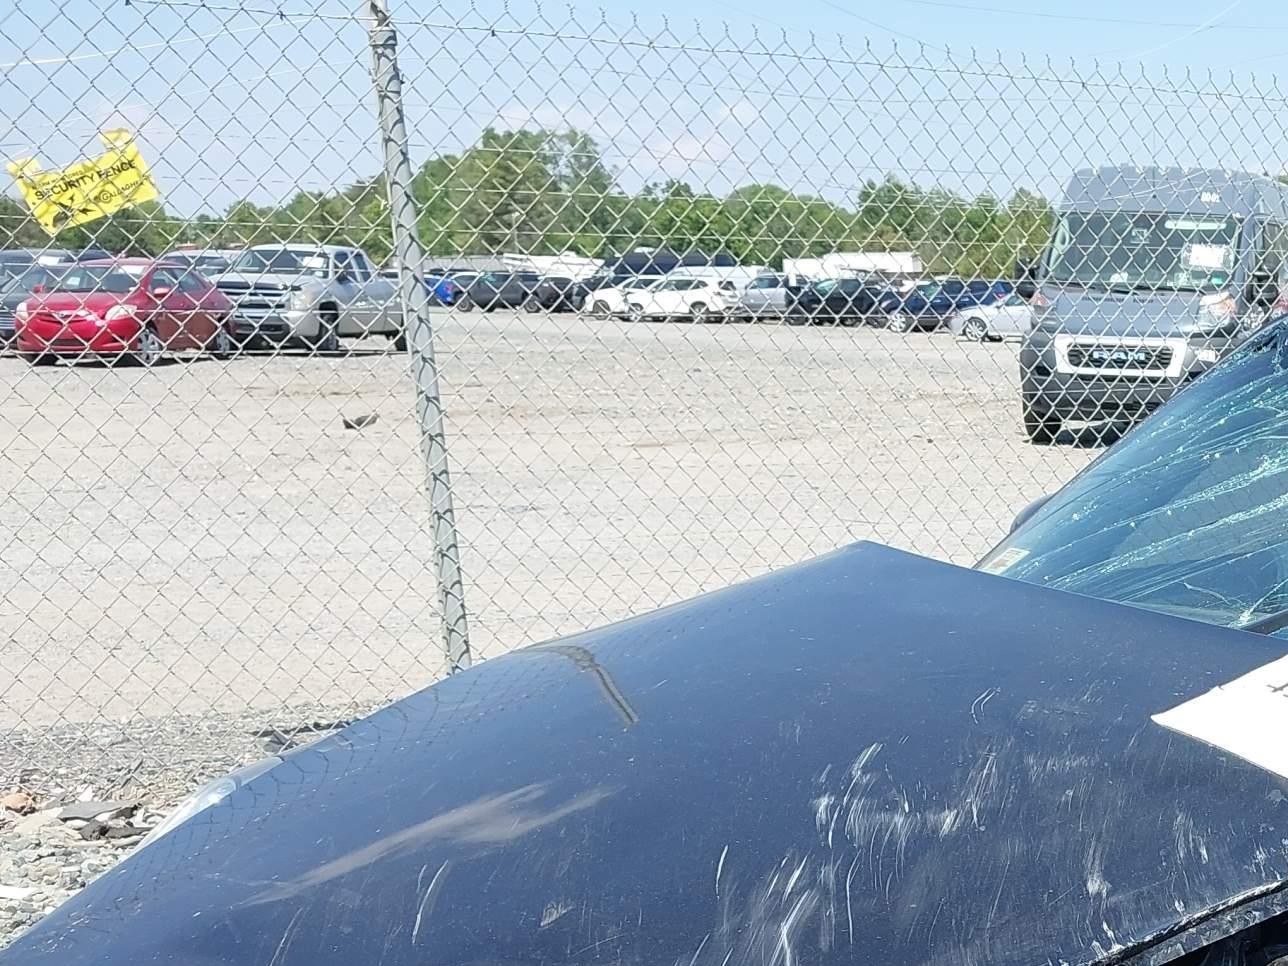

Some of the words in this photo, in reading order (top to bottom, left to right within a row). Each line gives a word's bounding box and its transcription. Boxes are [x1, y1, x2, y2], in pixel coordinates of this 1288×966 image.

[34, 172, 95, 201] SECURITY
[97, 159, 136, 180] FENCE
[1092, 350, 1146, 361] RAM
